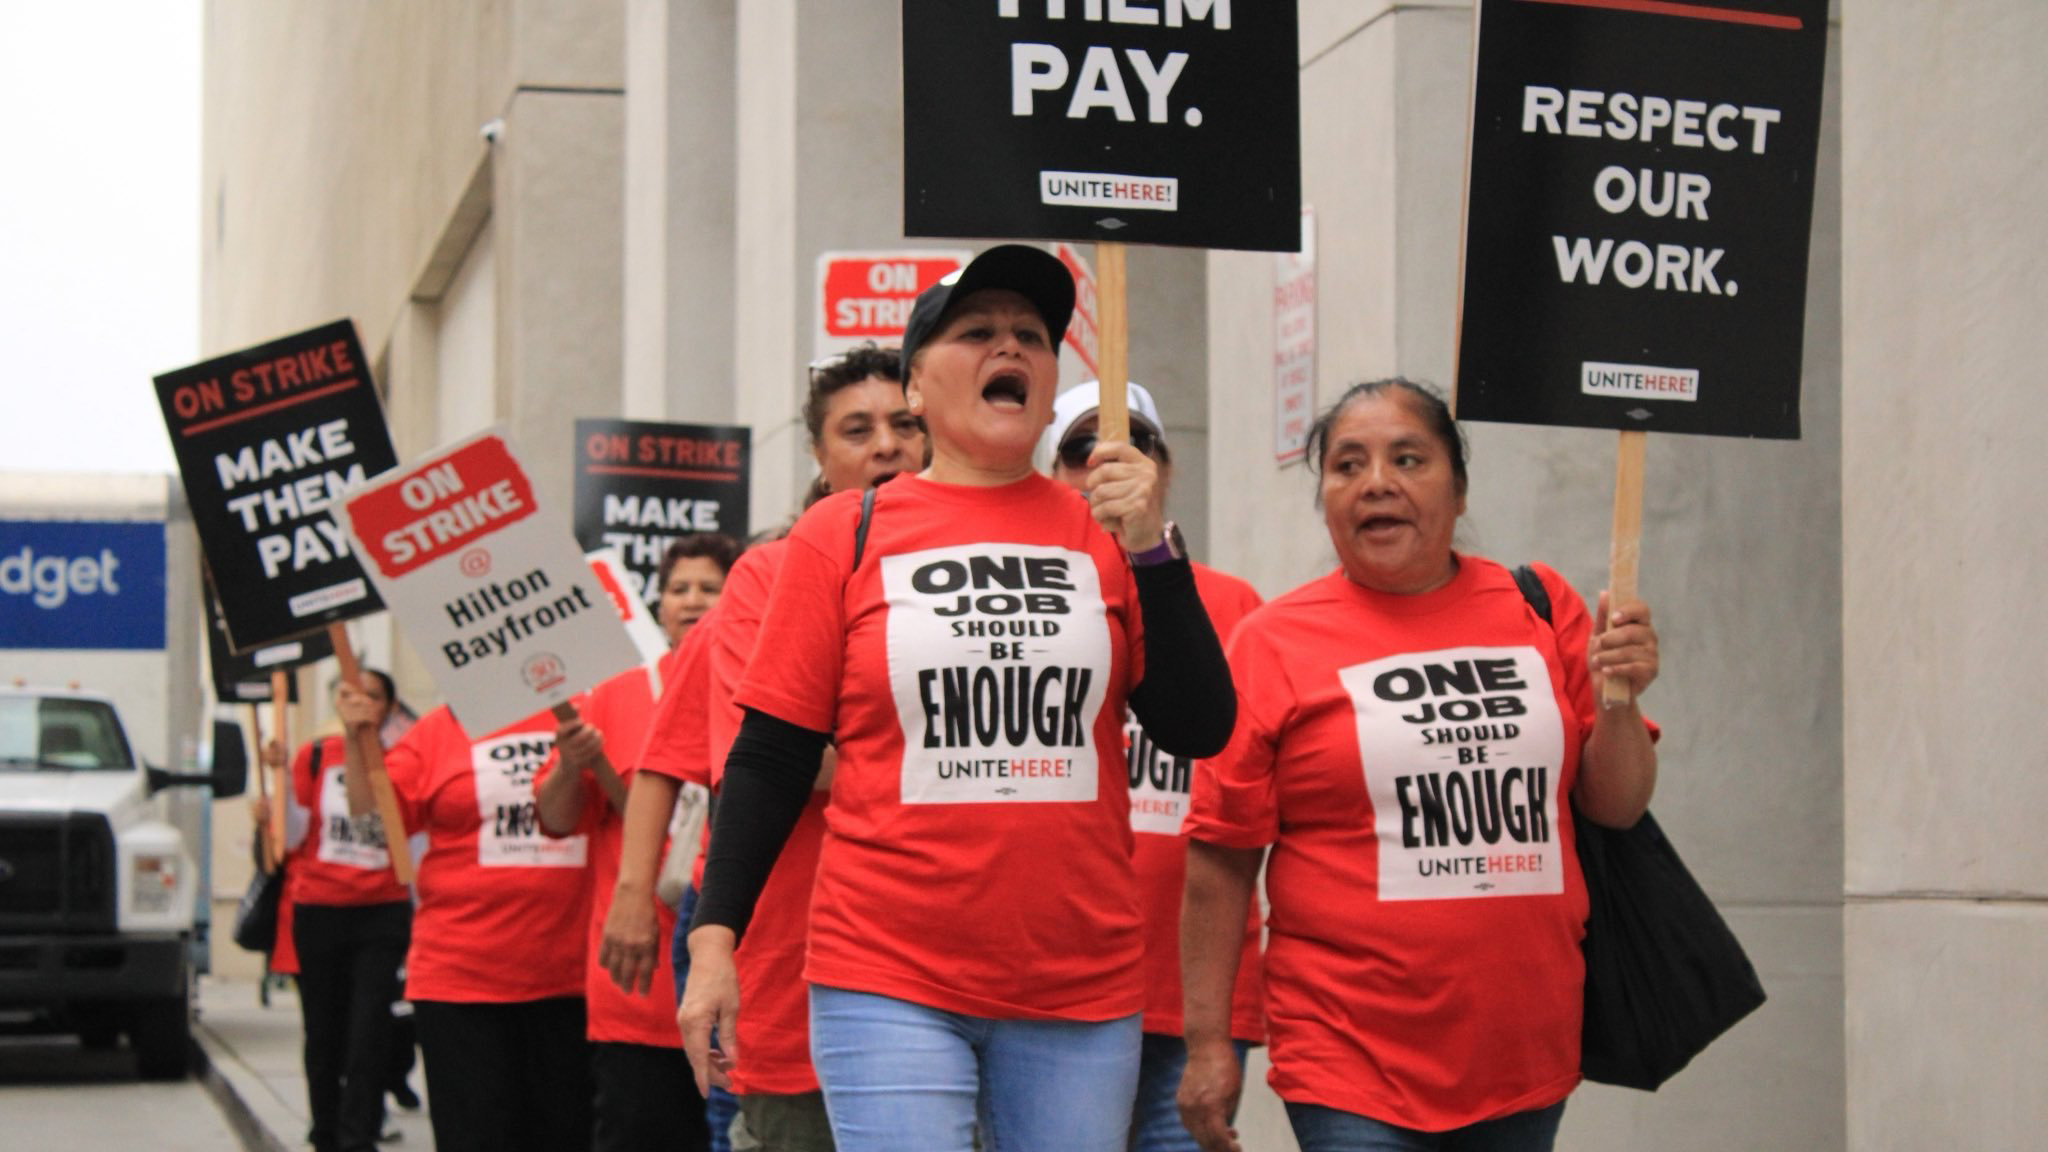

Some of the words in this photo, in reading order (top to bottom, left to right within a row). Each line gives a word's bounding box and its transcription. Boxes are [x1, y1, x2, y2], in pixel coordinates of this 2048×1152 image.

[1011, 43, 1203, 127] PAY.
[1522, 85, 1781, 154] RESPECT
[1048, 179, 1172, 203] UNITEHERE!
[1594, 165, 1712, 221] OUR
[867, 263, 918, 293] ON
[1552, 235, 1739, 297] WORK.
[173, 378, 225, 420] ON
[231, 339, 354, 403] STRIKE
[1588, 371, 1693, 394] UNITEHERE!
[215, 418, 355, 490] MAKE
[586, 432, 630, 462] ON
[638, 434, 742, 468] STRIKE
[400, 462, 464, 511] ON
[383, 479, 523, 565] STRIKE
[604, 494, 720, 531] MAKE
[460, 548, 491, 578] @
[911, 555, 1076, 595] ONE
[444, 568, 550, 628] Hilton
[933, 593, 1071, 617] JOB
[442, 584, 593, 668] Bayfront
[951, 620, 1060, 638] SHOULD
[990, 641, 1025, 661] BE
[1373, 657, 1528, 702] ONE
[918, 665, 1092, 749] ENOUGH
[1401, 695, 1528, 724] JOB
[490, 741, 556, 760] ON
[1421, 723, 1521, 745] SHOULD
[938, 759, 1073, 779] UNITEHERE!
[1457, 745, 1489, 765] BE
[1395, 767, 1549, 849] ENOUGH
[1419, 854, 1542, 877] UNITEHERE!
